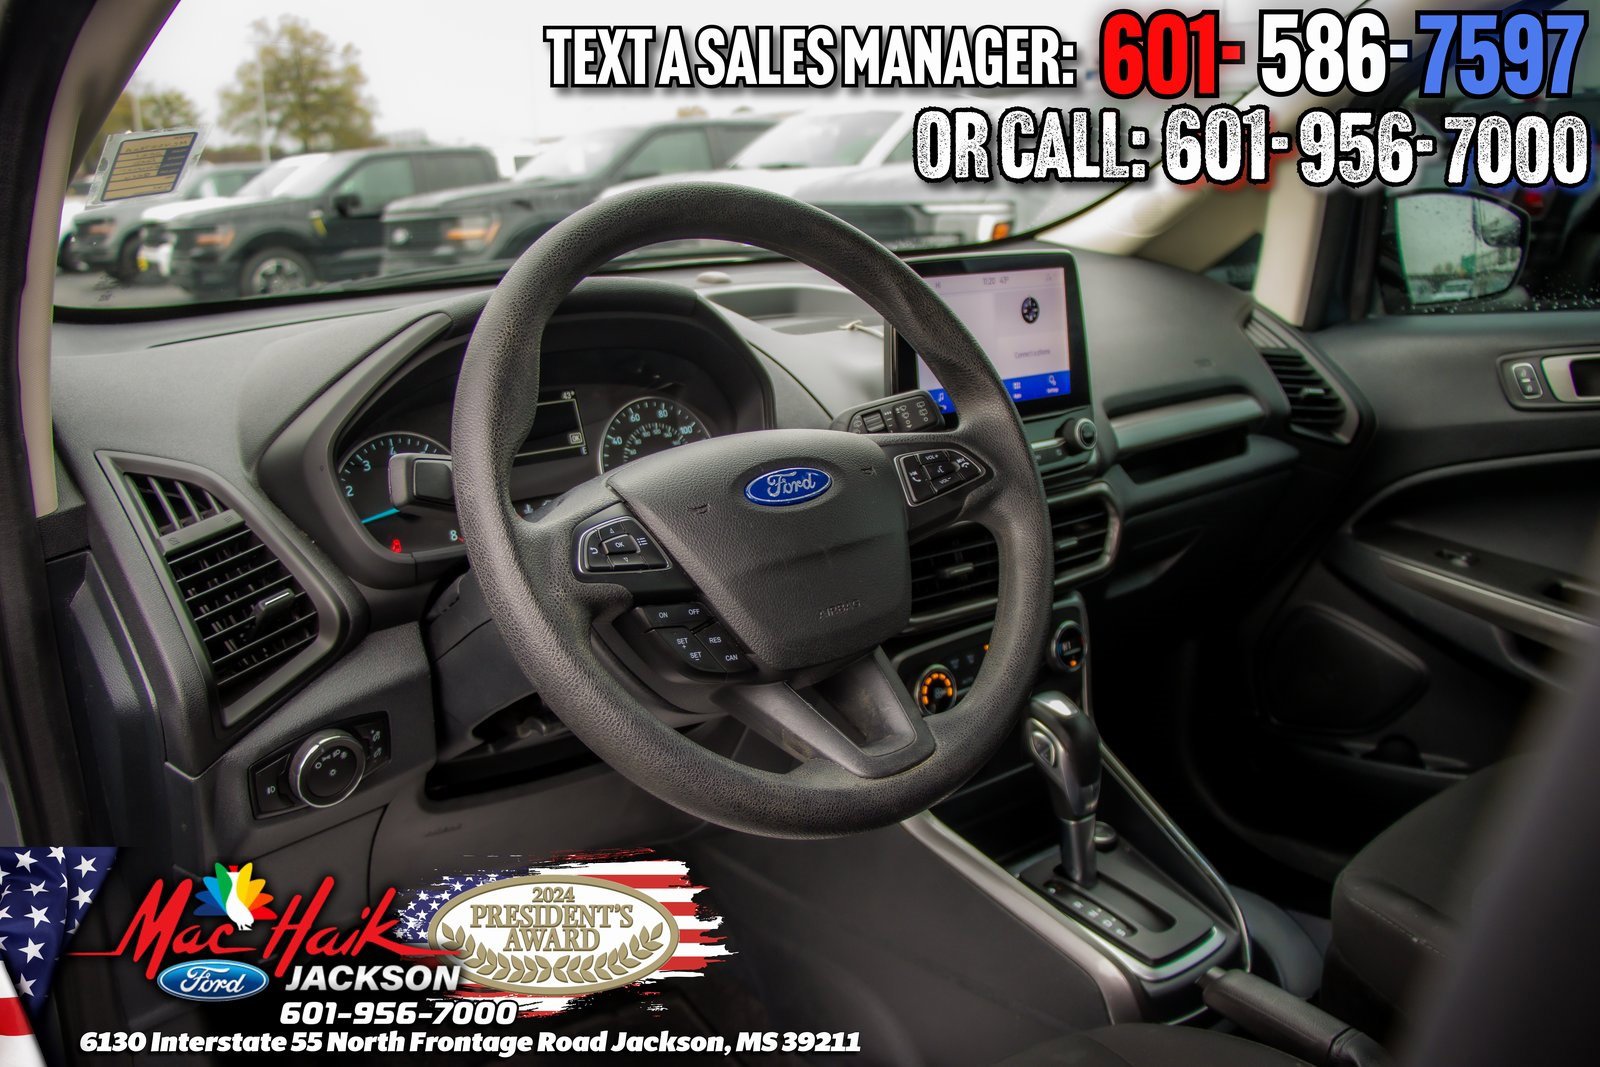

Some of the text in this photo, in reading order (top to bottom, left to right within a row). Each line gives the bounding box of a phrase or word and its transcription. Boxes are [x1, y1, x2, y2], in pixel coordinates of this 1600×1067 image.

[630, 413, 641, 423] 60
[657, 409, 668, 419] 80
[679, 425, 693, 435] 100
[612, 436, 623, 446] 40
[362, 460, 372, 472] 3
[766, 470, 817, 497] Ford
[345, 485, 354, 498] 2
[449, 529, 458, 541] 8
[615, 541, 625, 549] OK
[658, 608, 700, 619] ON OFF
[676, 637, 689, 645] SET
[708, 636, 722, 644] RES
[689, 651, 702, 659] SET
[725, 654, 739, 662] CAN
